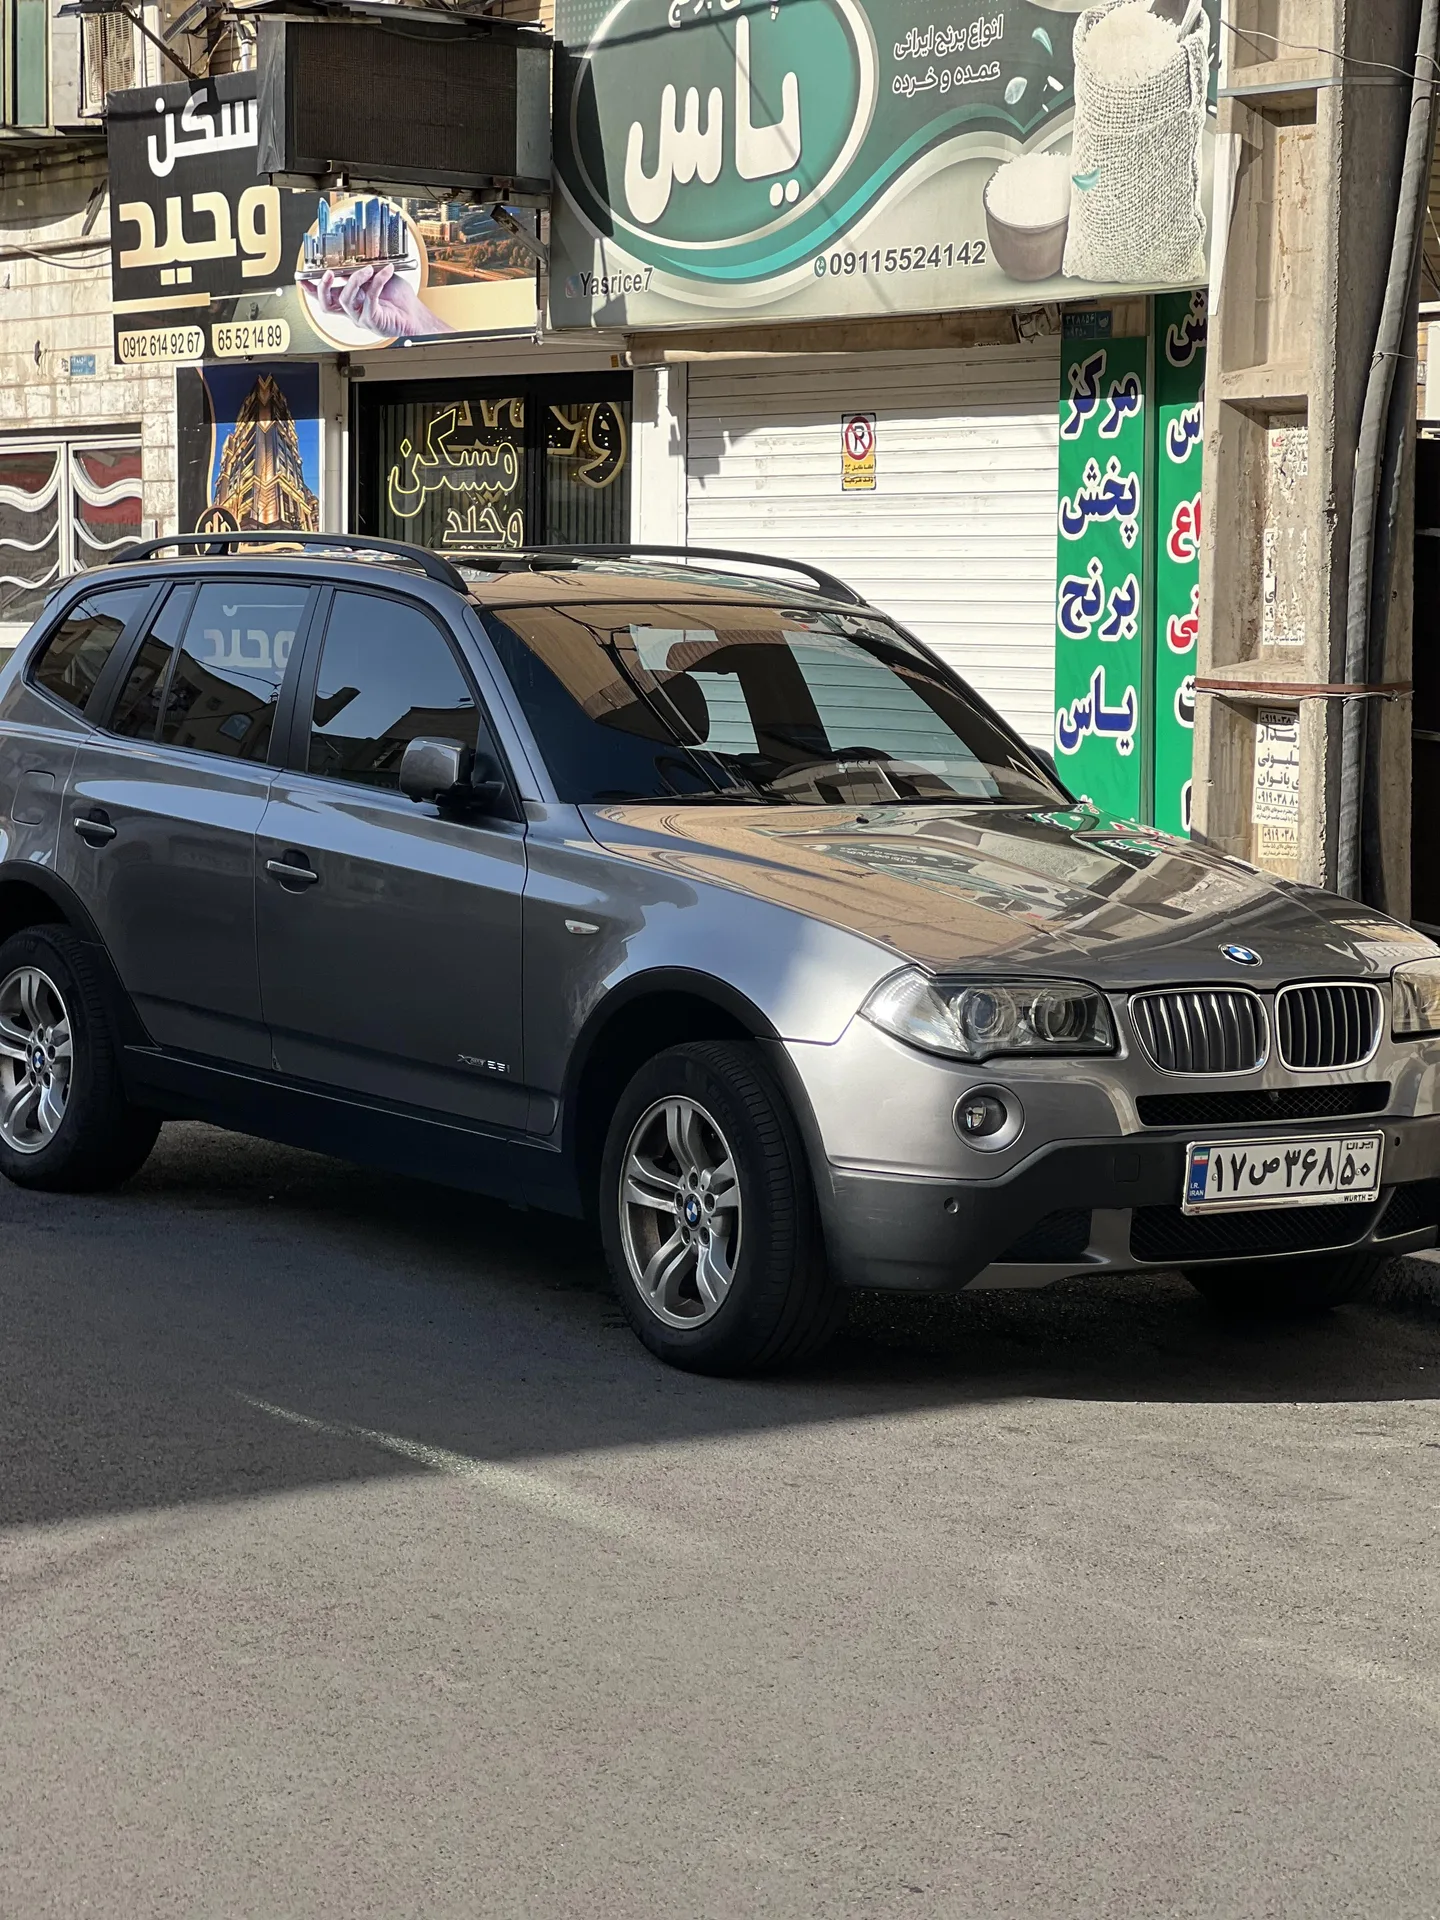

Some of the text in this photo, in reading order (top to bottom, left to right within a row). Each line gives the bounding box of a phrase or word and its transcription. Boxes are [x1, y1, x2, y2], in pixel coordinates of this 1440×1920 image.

[892, 60, 1001, 97] عمده و خرده
[893, 13, 1004, 60] انواع برنج ایرانی
[147, 87, 258, 177] سکن
[624, 15, 801, 224] یاس
[119, 185, 282, 285] وحید
[829, 241, 986, 276] 09115524142
[580, 267, 654, 296] Yasrice7
[1061, 350, 1141, 439] مرکز
[388, 408, 518, 517] مسکن
[1059, 456, 1140, 548] پخش
[1057, 557, 1139, 640] برنج
[1056, 666, 1137, 754] یاس
[1258, 747, 1299, 768] لیونی
[1346, 1141, 1374, 1151] ایران
